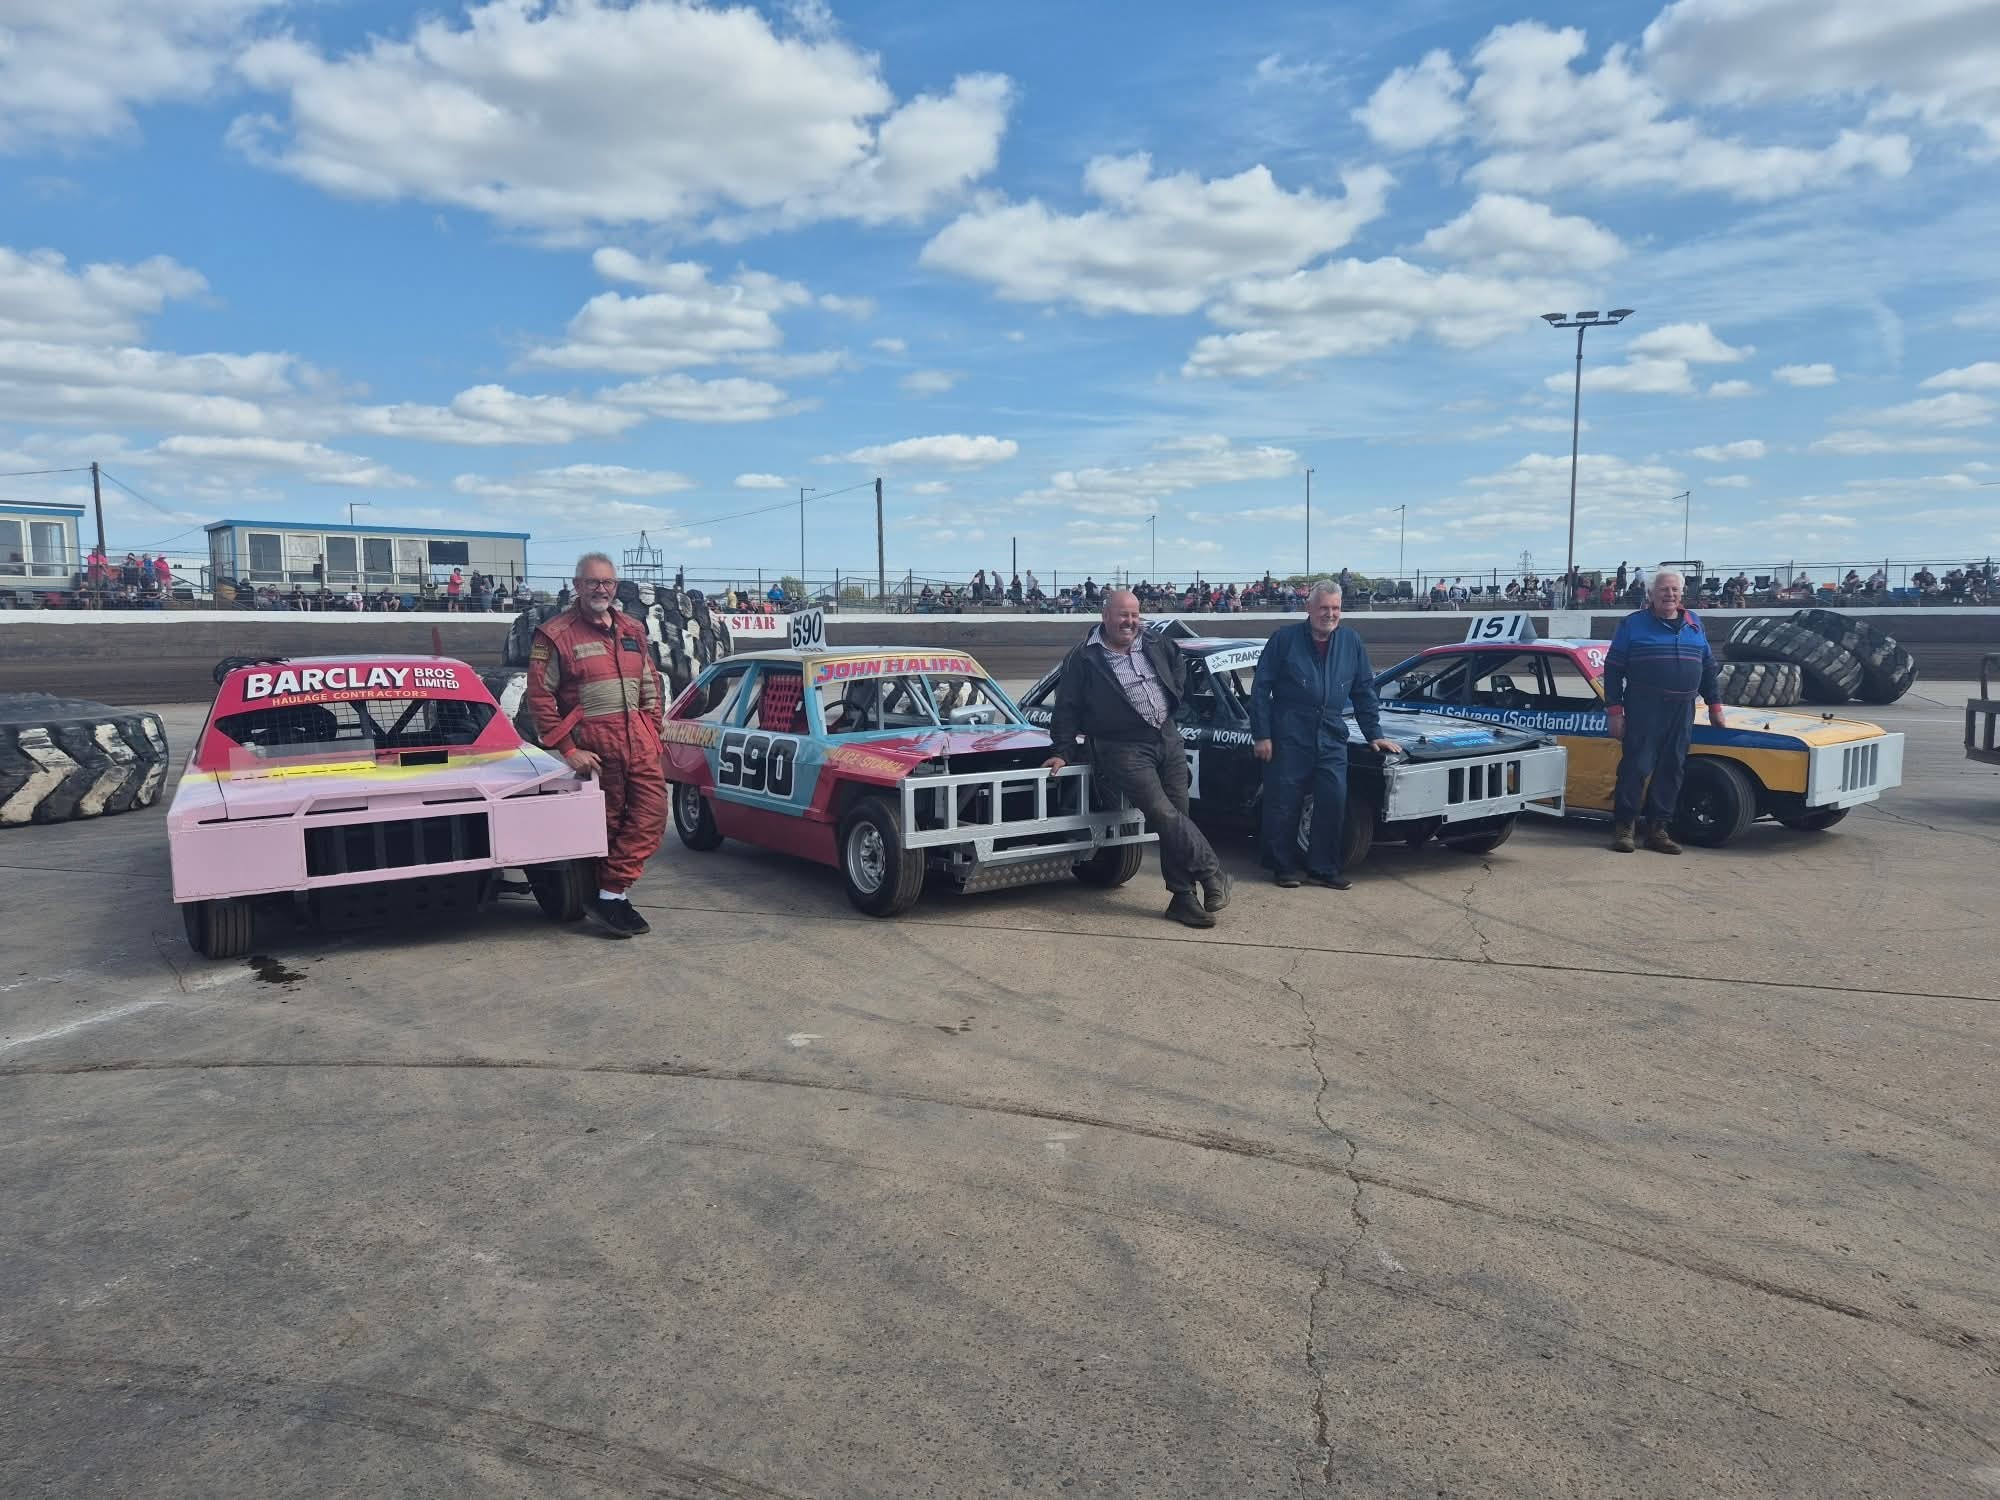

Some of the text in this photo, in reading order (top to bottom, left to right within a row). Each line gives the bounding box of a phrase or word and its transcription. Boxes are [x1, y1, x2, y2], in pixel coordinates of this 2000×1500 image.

[732, 616, 776, 630] STAR
[792, 611, 822, 647] 590
[1472, 615, 1521, 639] 151
[1228, 649, 1264, 665] TRANS
[414, 668, 456, 678] BROS
[814, 657, 978, 684] JOHN HALIFAX
[246, 667, 410, 700] BARCLAY
[415, 678, 460, 690] LIMITED
[272, 690, 428, 706] HAULAGE CONTRACTORS
[1503, 710, 1580, 733] (Scotland)
[1582, 714, 1608, 732] Ltd.
[1213, 730, 1255, 745] NORWI
[718, 729, 799, 800] 590
